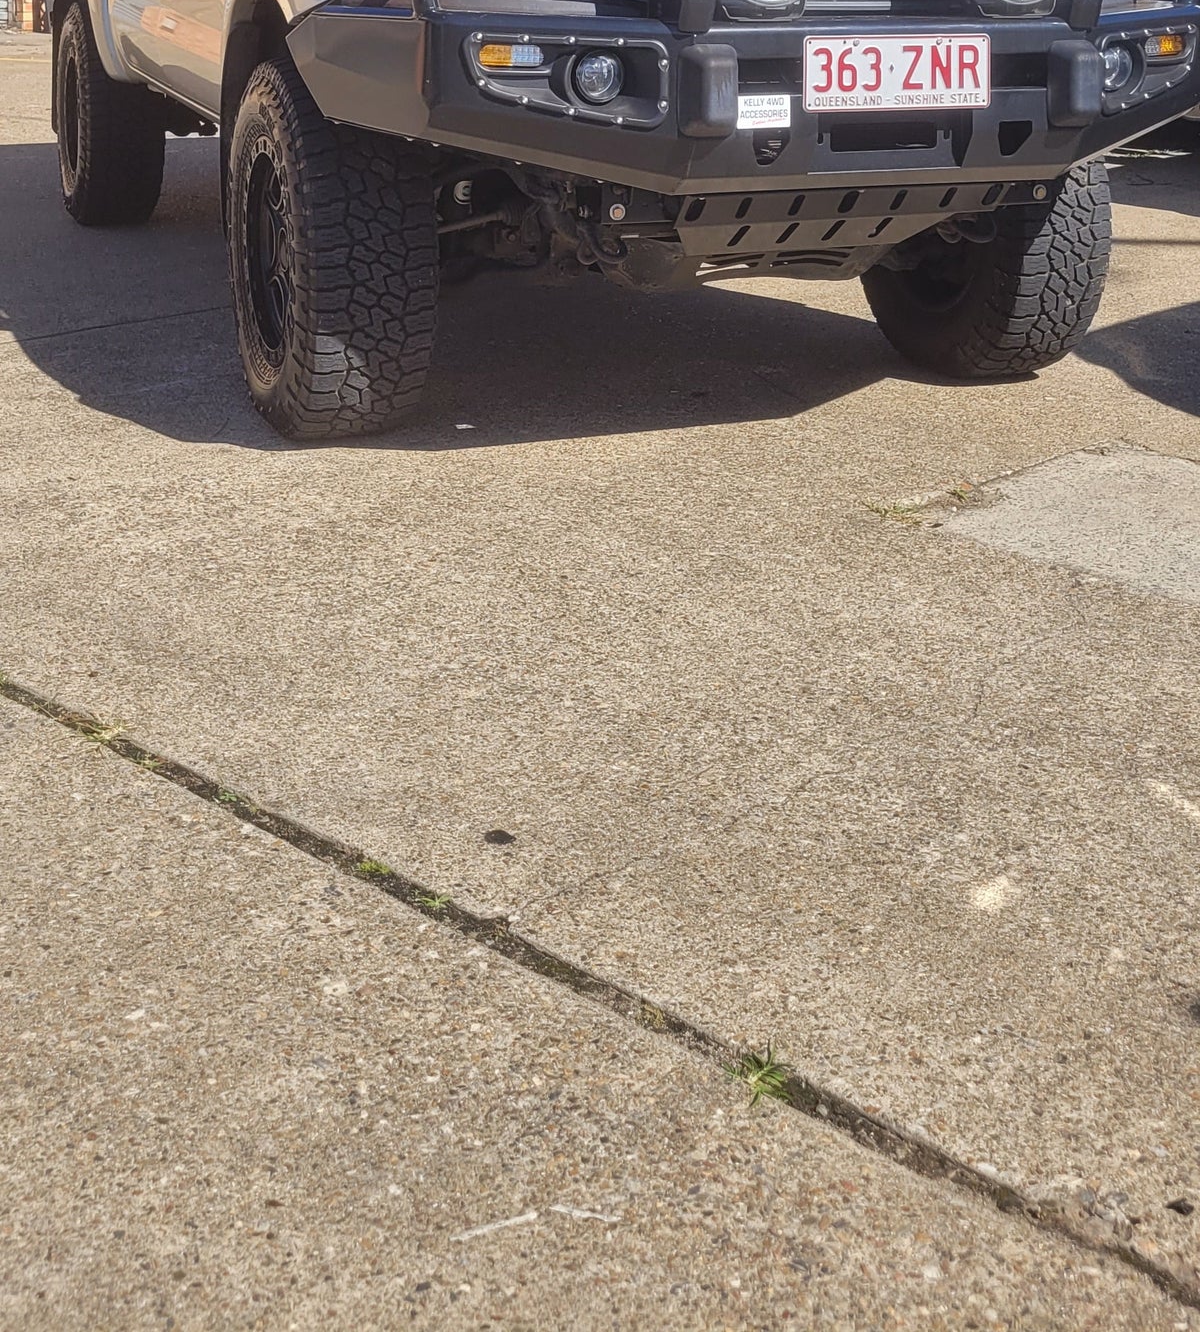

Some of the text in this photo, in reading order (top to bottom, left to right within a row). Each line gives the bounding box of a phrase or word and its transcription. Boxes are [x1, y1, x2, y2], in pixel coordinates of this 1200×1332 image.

[812, 44, 980, 93] 363 ZNR
[744, 97, 784, 107] KELLY 4WD
[814, 93, 883, 107] QUEENSLAND
[893, 93, 945, 106] SUNSHINE
[950, 92, 980, 105] STATE
[740, 109, 788, 119] ACCESSORIES
